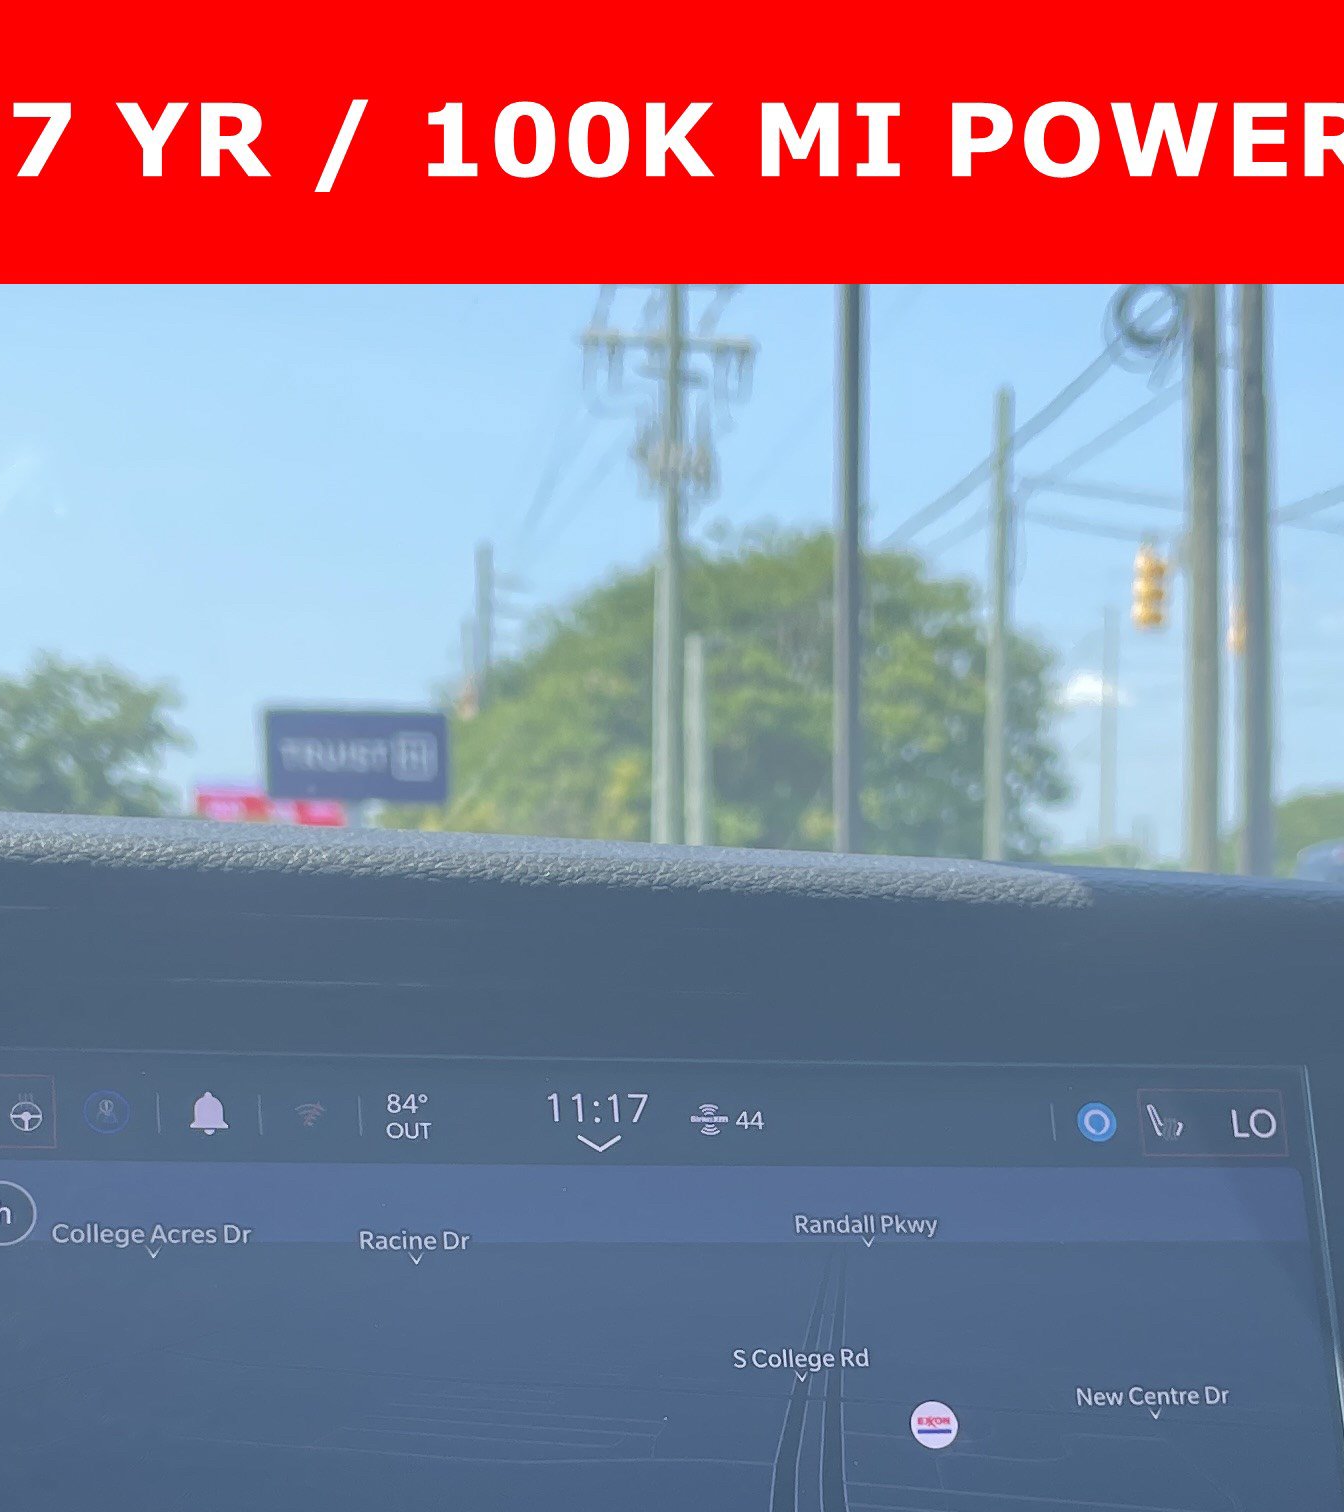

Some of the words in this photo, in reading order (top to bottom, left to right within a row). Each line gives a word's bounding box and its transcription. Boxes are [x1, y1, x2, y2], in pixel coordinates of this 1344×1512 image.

[386, 1093, 429, 1115] 84°
[547, 1092, 649, 1125] 11:17
[385, 1122, 432, 1141] OUT
[735, 1110, 766, 1131] 44
[1231, 1108, 1278, 1140] LO
[52, 1223, 146, 1250] College
[150, 1224, 218, 1245] Acres
[224, 1224, 253, 1245] Dr
[794, 1213, 876, 1235] Randall
[880, 1214, 939, 1239] Pkwy
[359, 1230, 438, 1251] Racine
[443, 1230, 471, 1251] Dr
[732, 1349, 748, 1370] S
[751, 1348, 836, 1374] College
[840, 1347, 870, 1368] Rd
[1076, 1387, 1125, 1407] New
[1128, 1386, 1201, 1406] Centre
[1204, 1385, 1230, 1405] Dr
